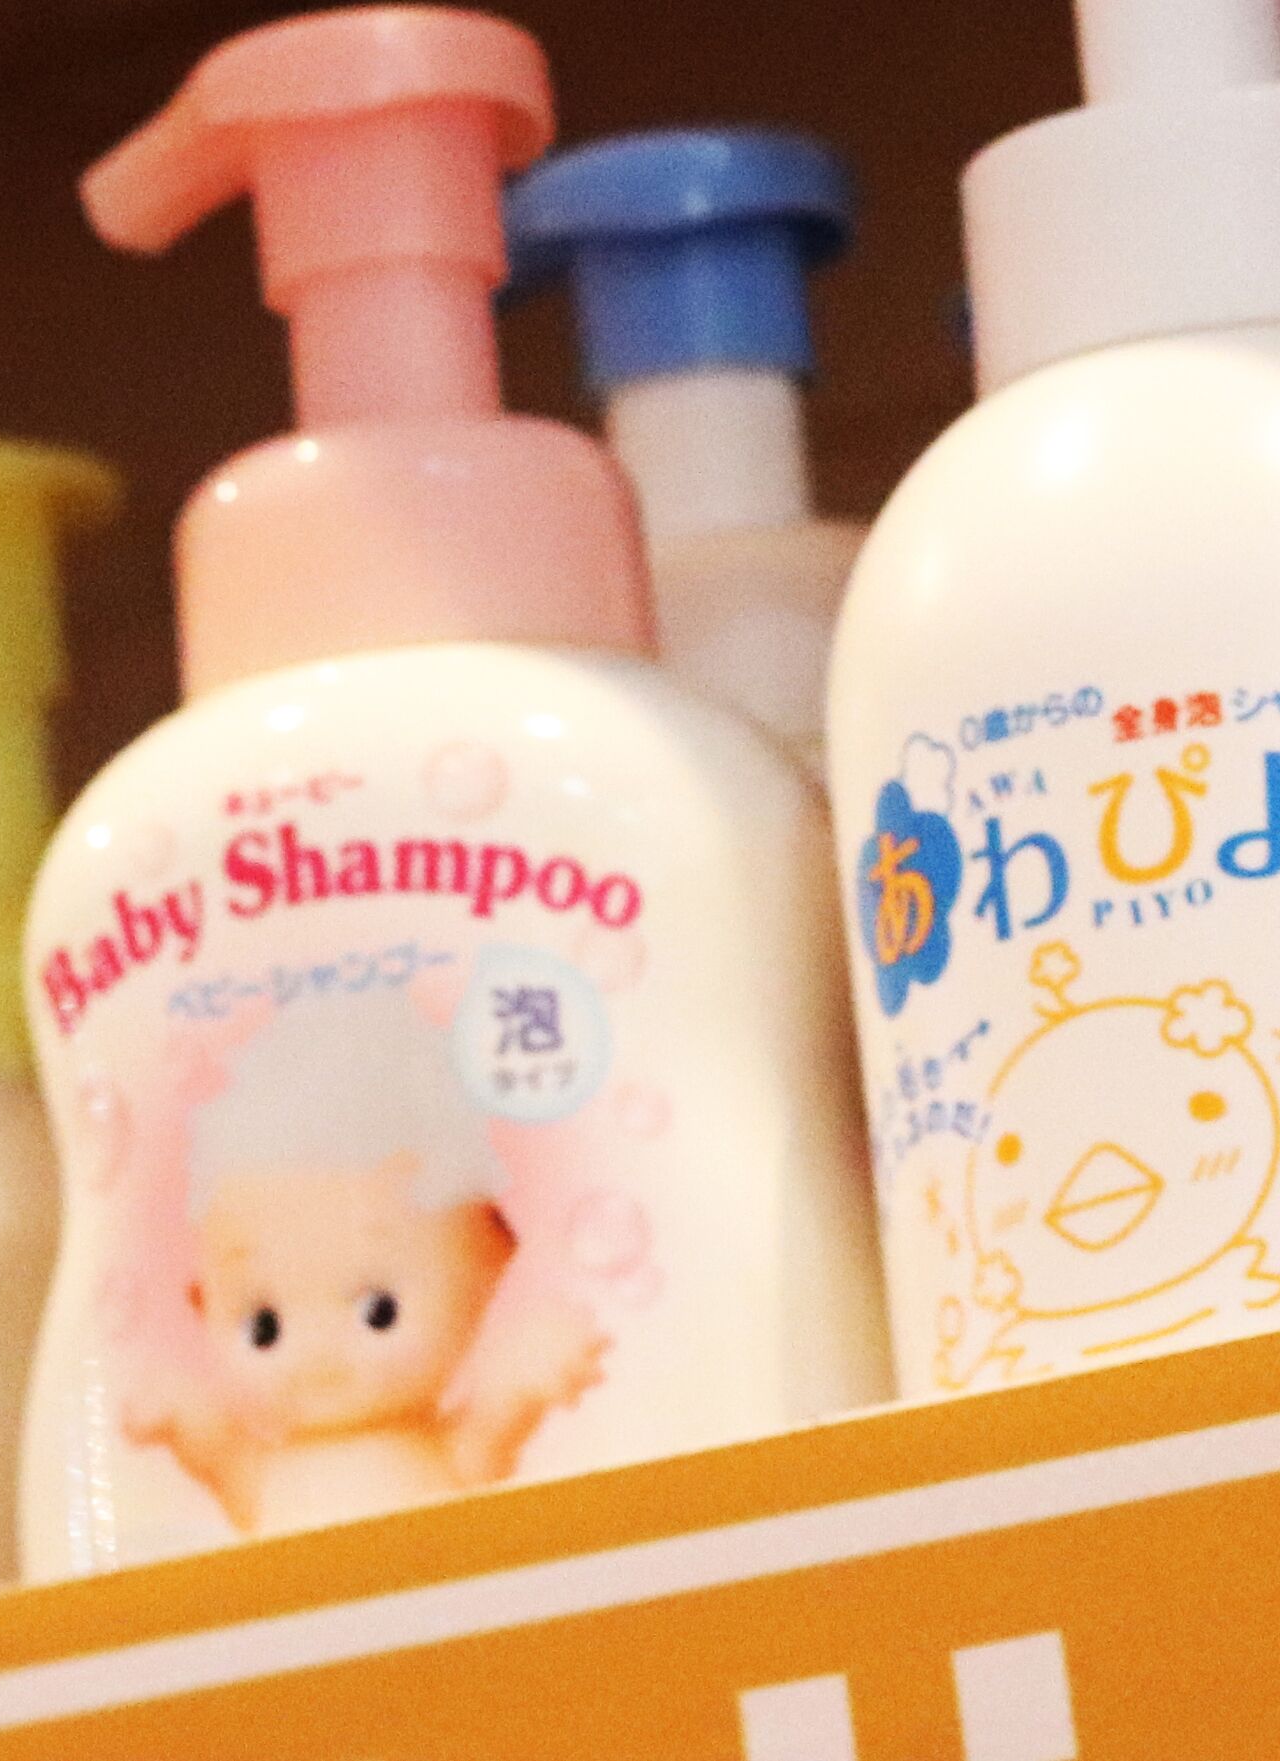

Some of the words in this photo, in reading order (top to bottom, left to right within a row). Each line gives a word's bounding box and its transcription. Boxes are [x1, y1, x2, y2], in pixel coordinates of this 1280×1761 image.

[966, 768, 1049, 813] AWA
[1092, 878, 1213, 927] PIYO
[41, 881, 204, 1036] Baby
[223, 820, 644, 929] Shampoo
